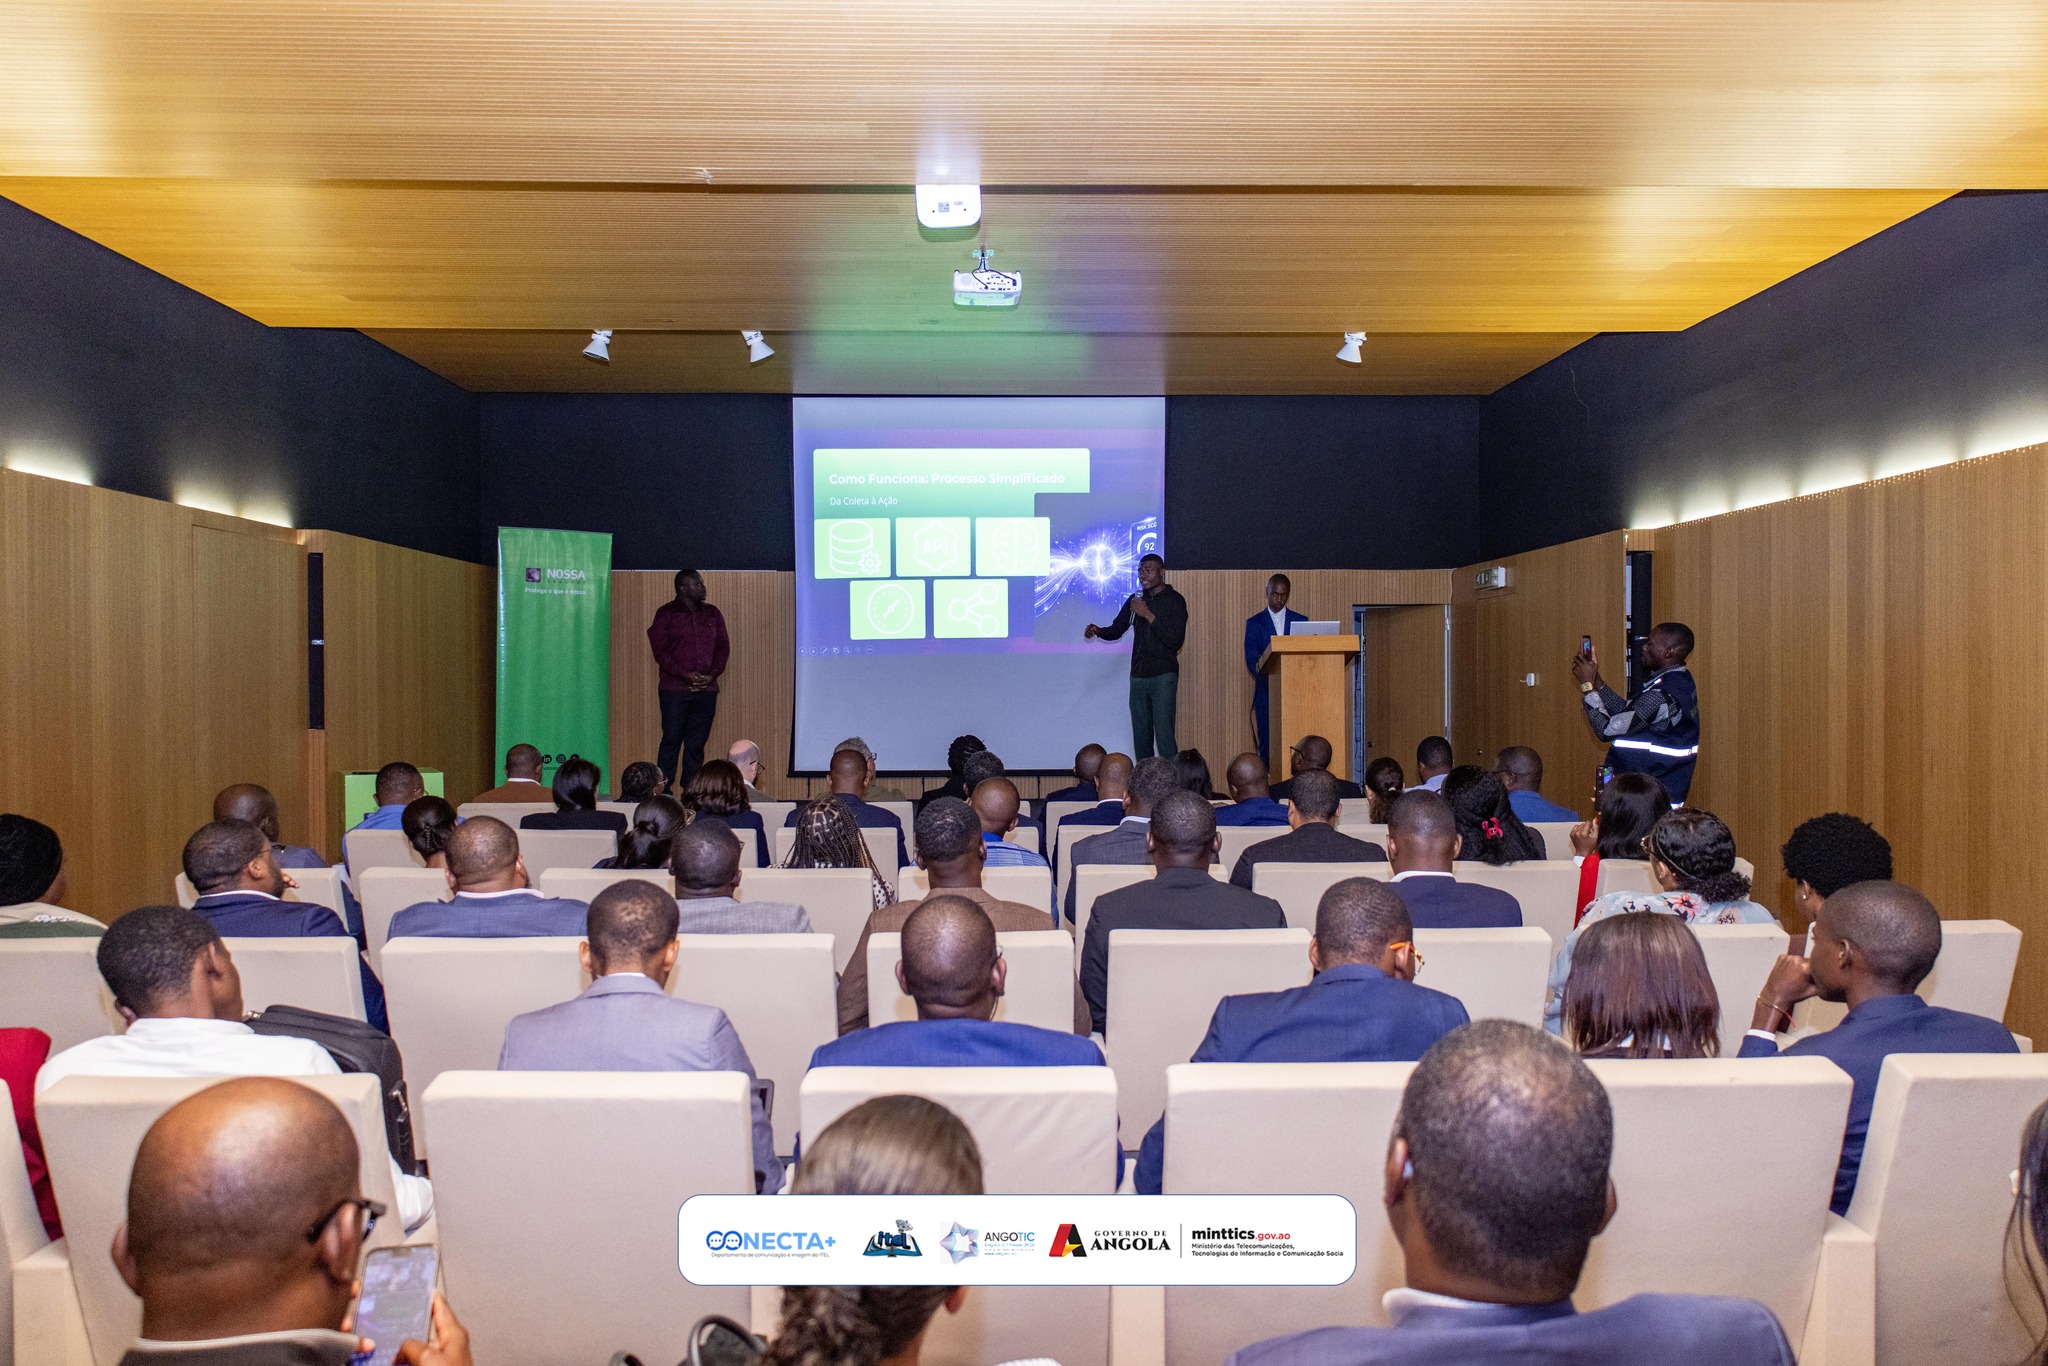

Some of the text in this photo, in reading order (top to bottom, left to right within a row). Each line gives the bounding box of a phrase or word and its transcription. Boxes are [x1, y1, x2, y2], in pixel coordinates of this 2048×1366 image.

[829, 472, 1065, 486] Como Funciona: Processo Simplificado
[829, 496, 898, 507] Da Coleta à Ação
[922, 539, 949, 554] API
[1144, 542, 1155, 551] 92
[546, 568, 586, 580] NOSSA
[525, 587, 547, 595] Protege
